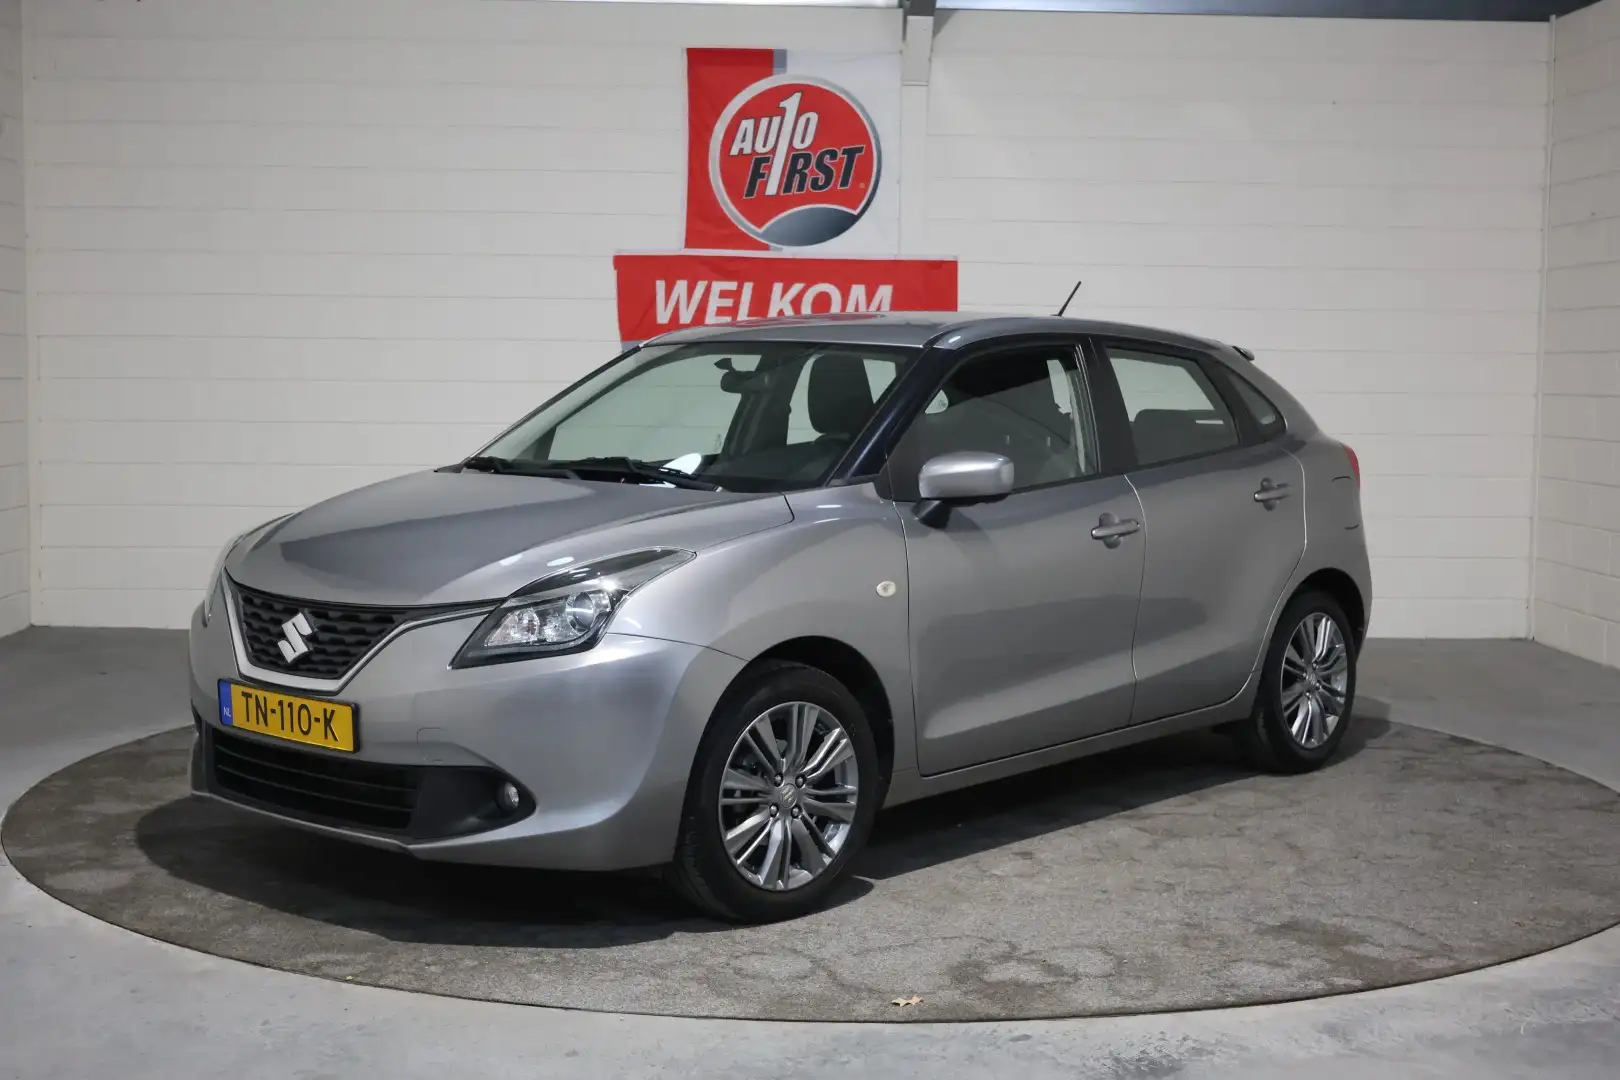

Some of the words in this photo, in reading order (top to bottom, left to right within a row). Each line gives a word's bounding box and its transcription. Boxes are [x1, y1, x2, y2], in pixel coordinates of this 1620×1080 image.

[655, 279, 894, 325] WELKOM
[223, 706, 232, 718] NL
[241, 691, 339, 742] TN-110-K
